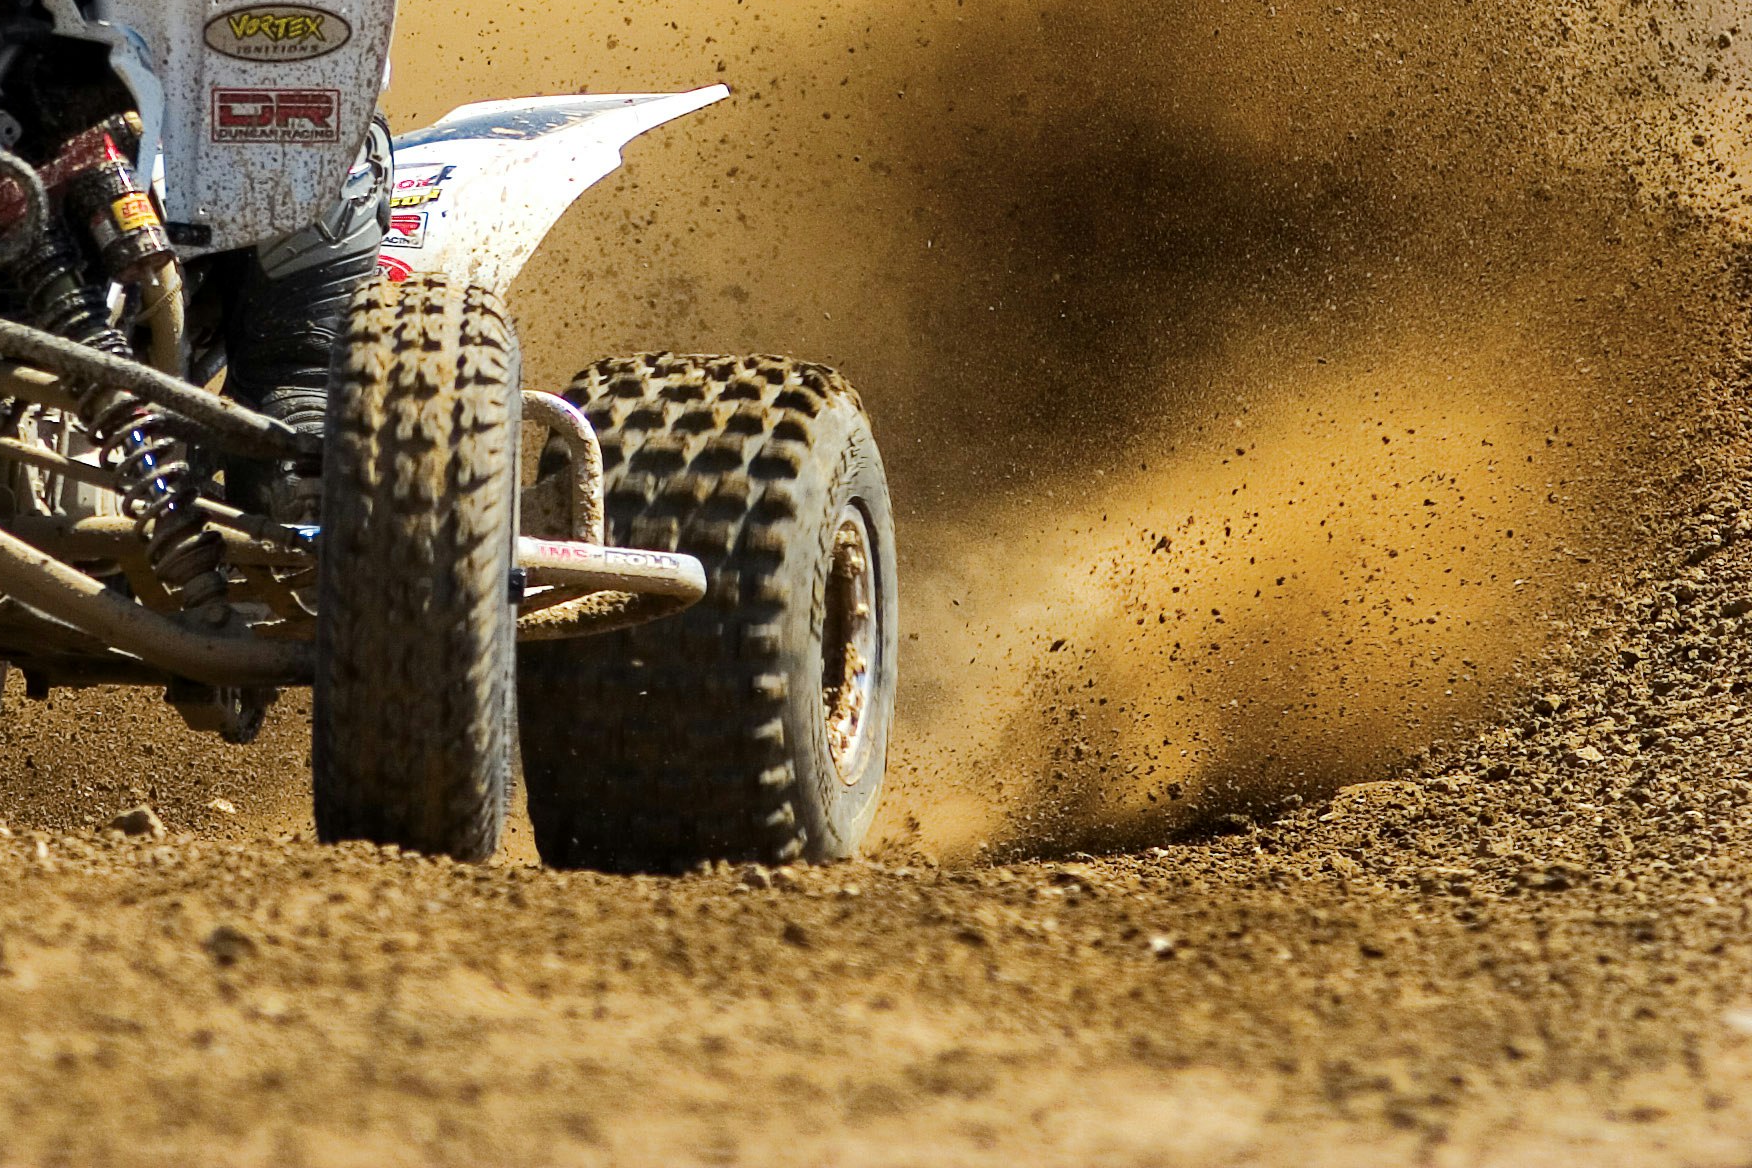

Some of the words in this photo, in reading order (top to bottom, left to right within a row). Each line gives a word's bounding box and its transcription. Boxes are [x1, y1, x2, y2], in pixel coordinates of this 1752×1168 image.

[228, 13, 326, 42] VORTEX
[235, 45, 320, 55] IGNITIONS
[218, 93, 334, 128] DR
[218, 128, 277, 139] DUNCAN
[280, 128, 335, 139] RACING
[382, 235, 419, 246] ACING
[604, 549, 680, 570] ROLL
